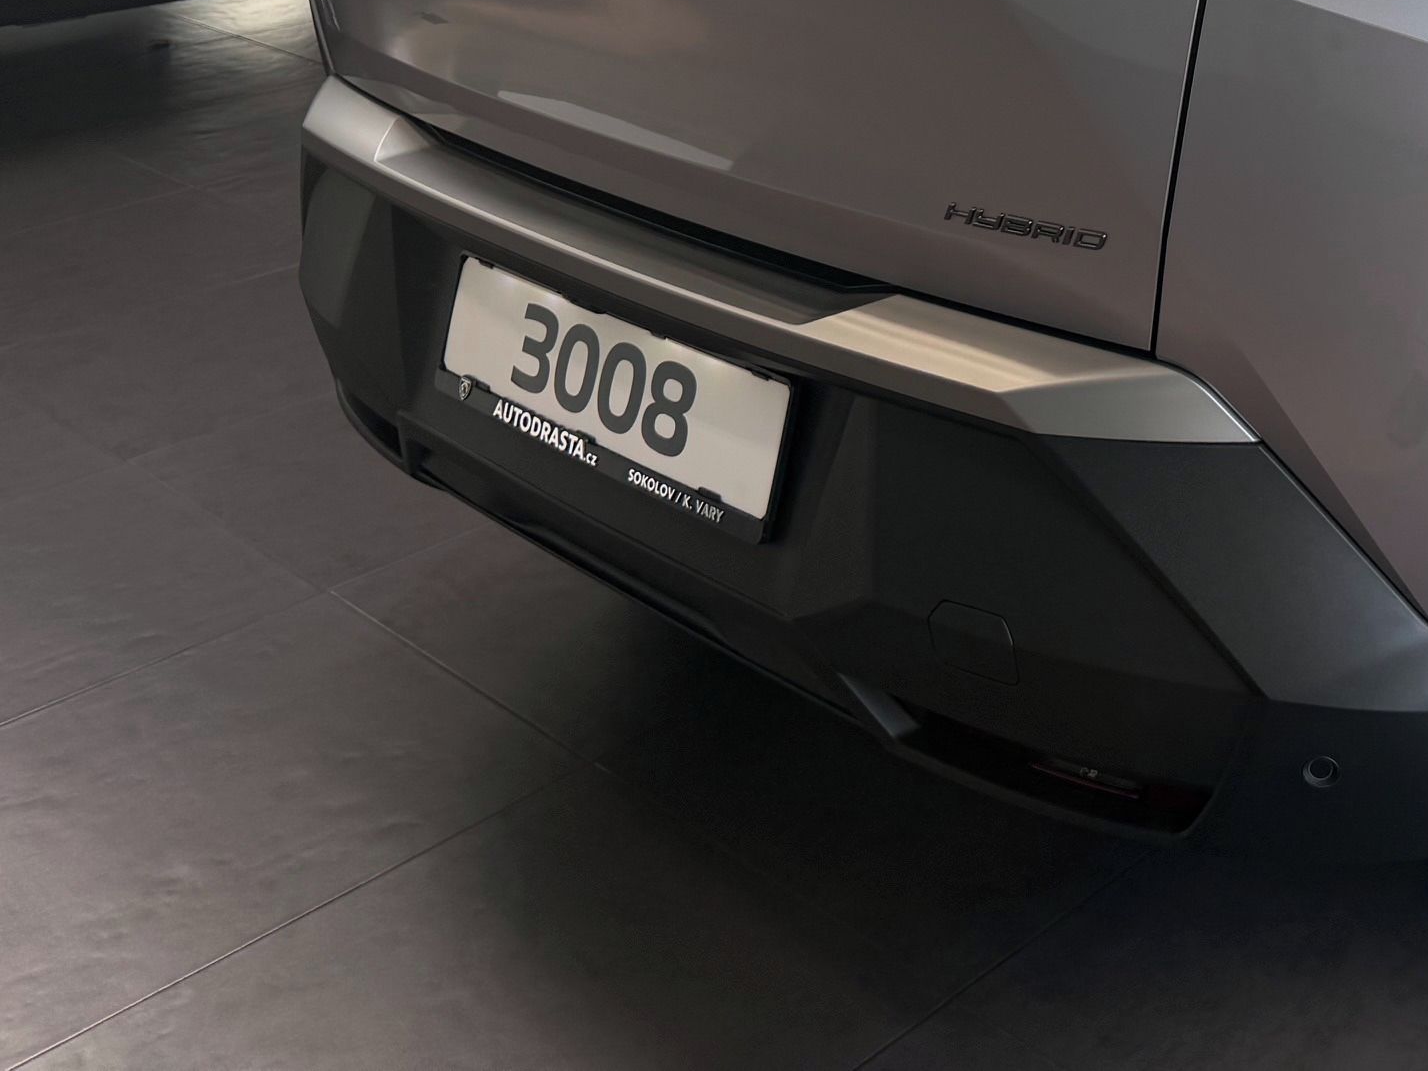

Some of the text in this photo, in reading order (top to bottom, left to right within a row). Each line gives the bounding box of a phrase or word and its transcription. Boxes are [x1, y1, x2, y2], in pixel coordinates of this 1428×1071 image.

[943, 201, 1108, 251] HYBRID
[510, 302, 697, 457] 3008
[492, 399, 598, 467] AUTODRASTA.cz
[627, 467, 676, 501] SOKOLOV
[681, 493, 693, 510] K.
[695, 499, 724, 524] VARY
